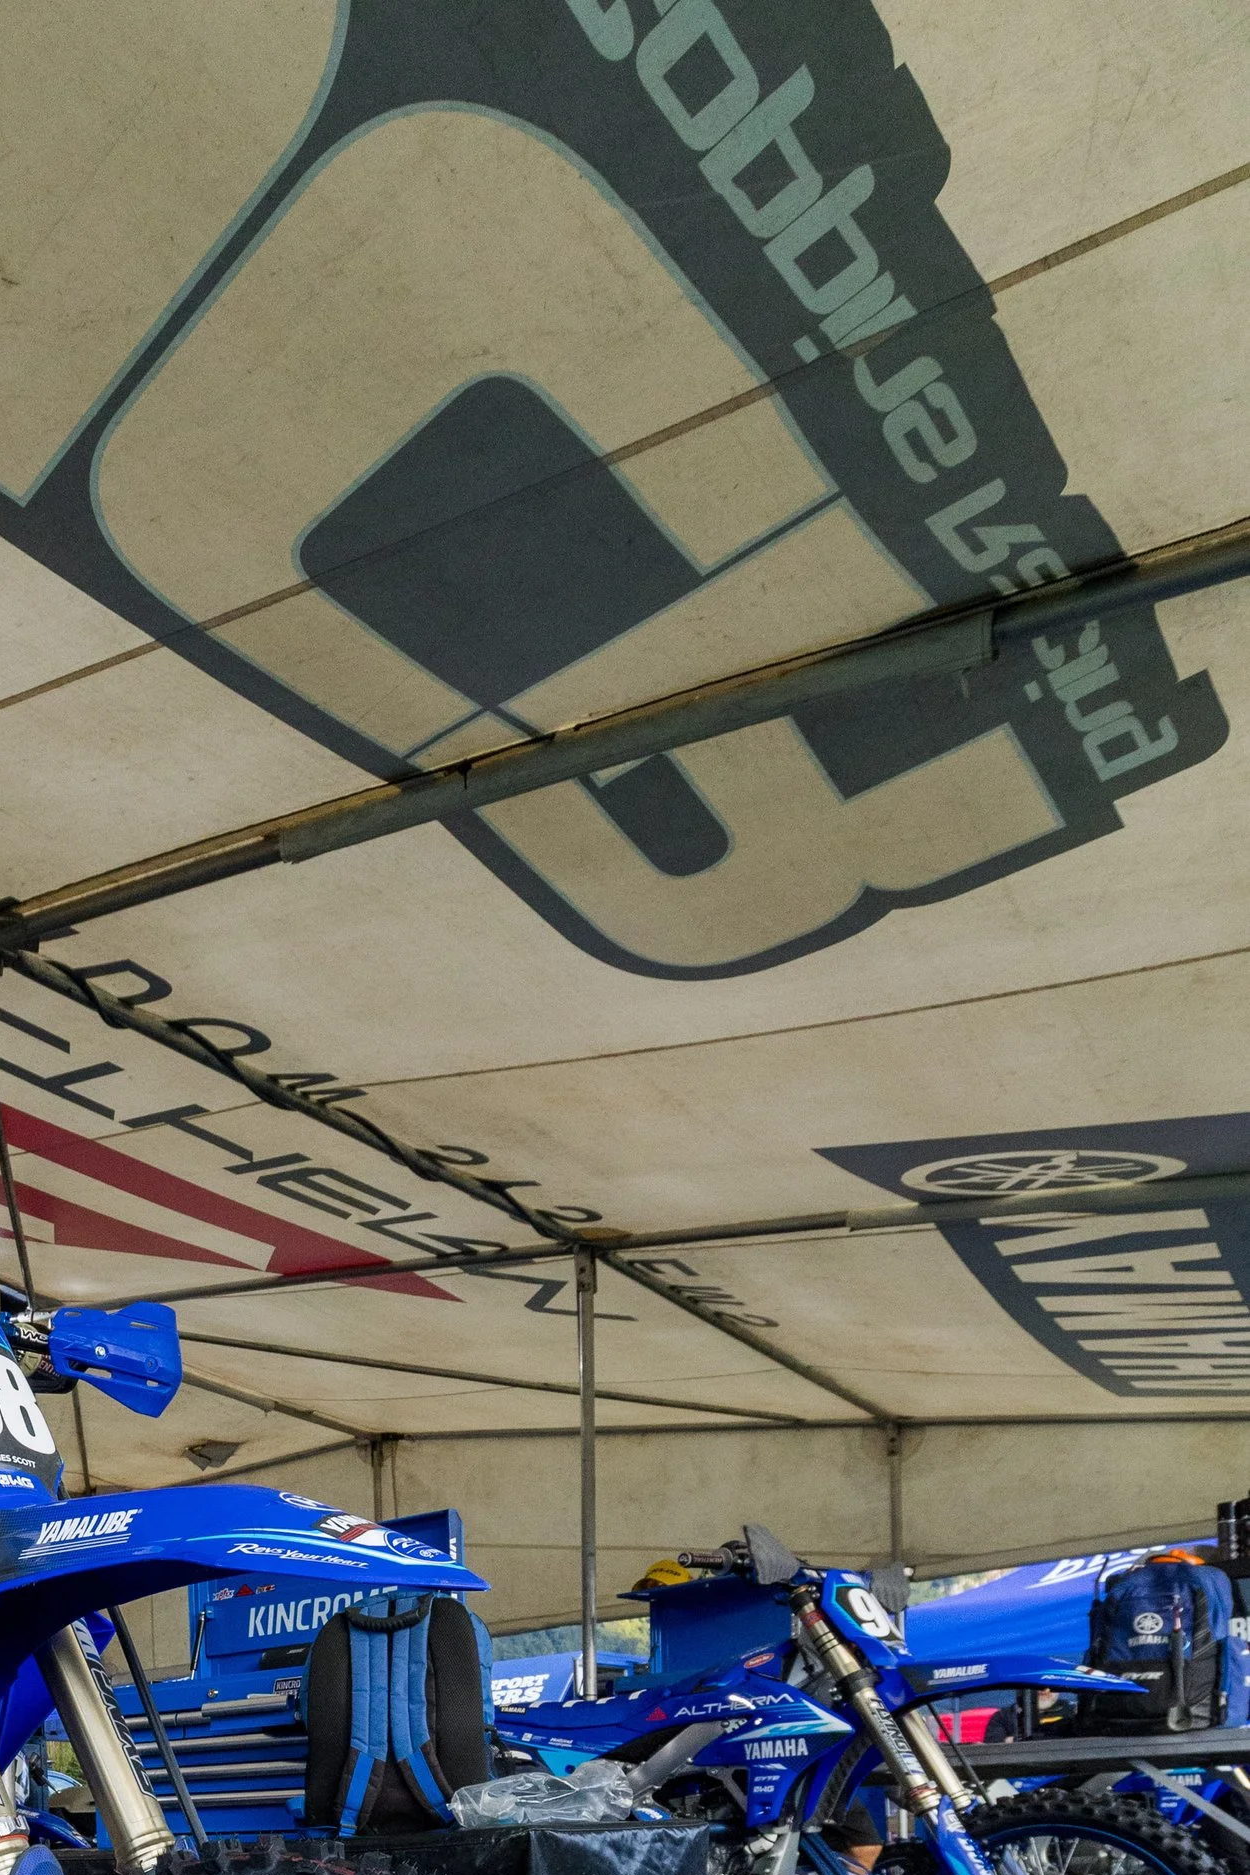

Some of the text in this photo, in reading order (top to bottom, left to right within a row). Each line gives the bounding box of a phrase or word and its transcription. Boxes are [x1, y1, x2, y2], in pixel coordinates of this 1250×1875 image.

[12, 1455, 36, 1468] SCOTT
[36, 1509, 136, 1545] YAMALUBE
[227, 1543, 285, 1555] Revs
[248, 1586, 399, 1638] KINCRO
[1128, 1635, 1170, 1647] YAMAHA
[932, 1664, 988, 1680] YAMALUBE
[744, 1738, 808, 1760] YAMAHA
